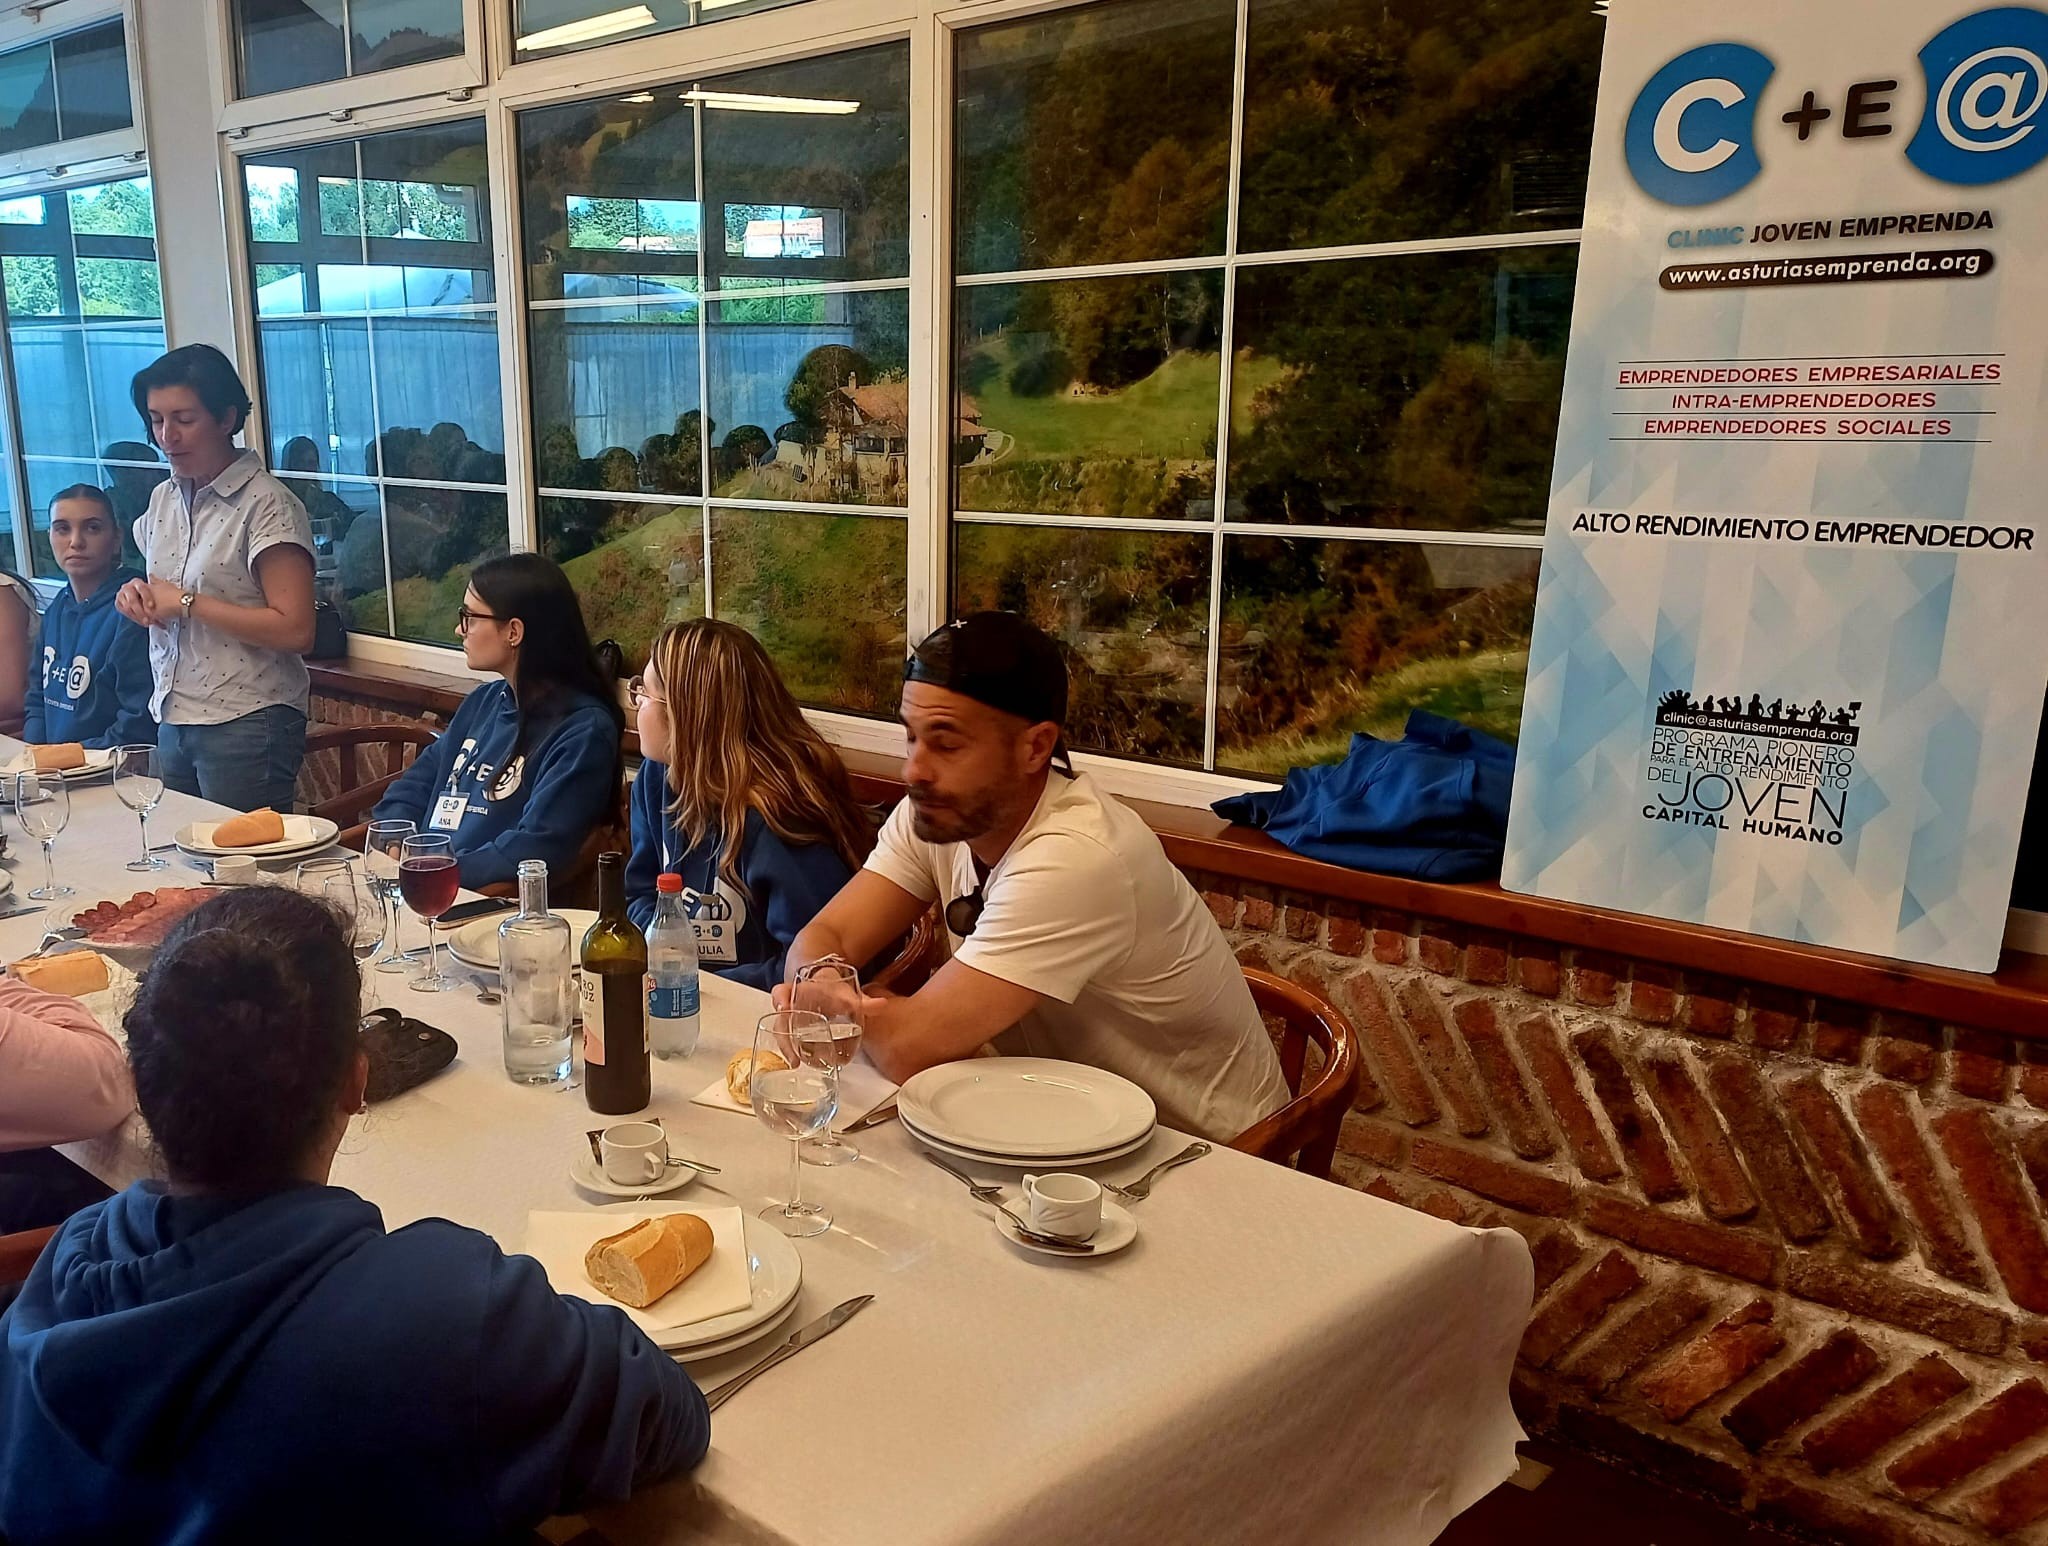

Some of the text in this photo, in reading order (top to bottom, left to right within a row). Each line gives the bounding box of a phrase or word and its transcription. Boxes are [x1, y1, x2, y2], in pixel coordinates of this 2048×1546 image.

[1667, 210, 1994, 250] CLINIC JOVEN EMPRENDA
[1669, 251, 1981, 285] www.asturiasemprenda.org
[1619, 363, 2001, 385] EMPRENDEDORES EMPRESARIALES
[1672, 392, 1937, 409] INTRA-EMPRENDEDORES
[1644, 418, 1952, 436] EMPRENDEDORES SOCIALES
[1572, 513, 2034, 551] ALTO RENDIMIENTO EMPRENDEDOR
[1653, 727, 1855, 763] PROGRAMA PIONERO
[1663, 712, 1854, 744] clinic@asturiasemprenda.org
[1650, 754, 1849, 790] PARA EL ALTO RENDIMIENTO
[1651, 741, 1852, 777] DE ENTRENAMIENTO
[1647, 766, 1847, 829] DEL JOVEN
[1642, 805, 1843, 845] CAPITAL HUMANO
[697, 945, 724, 955] ULIA
